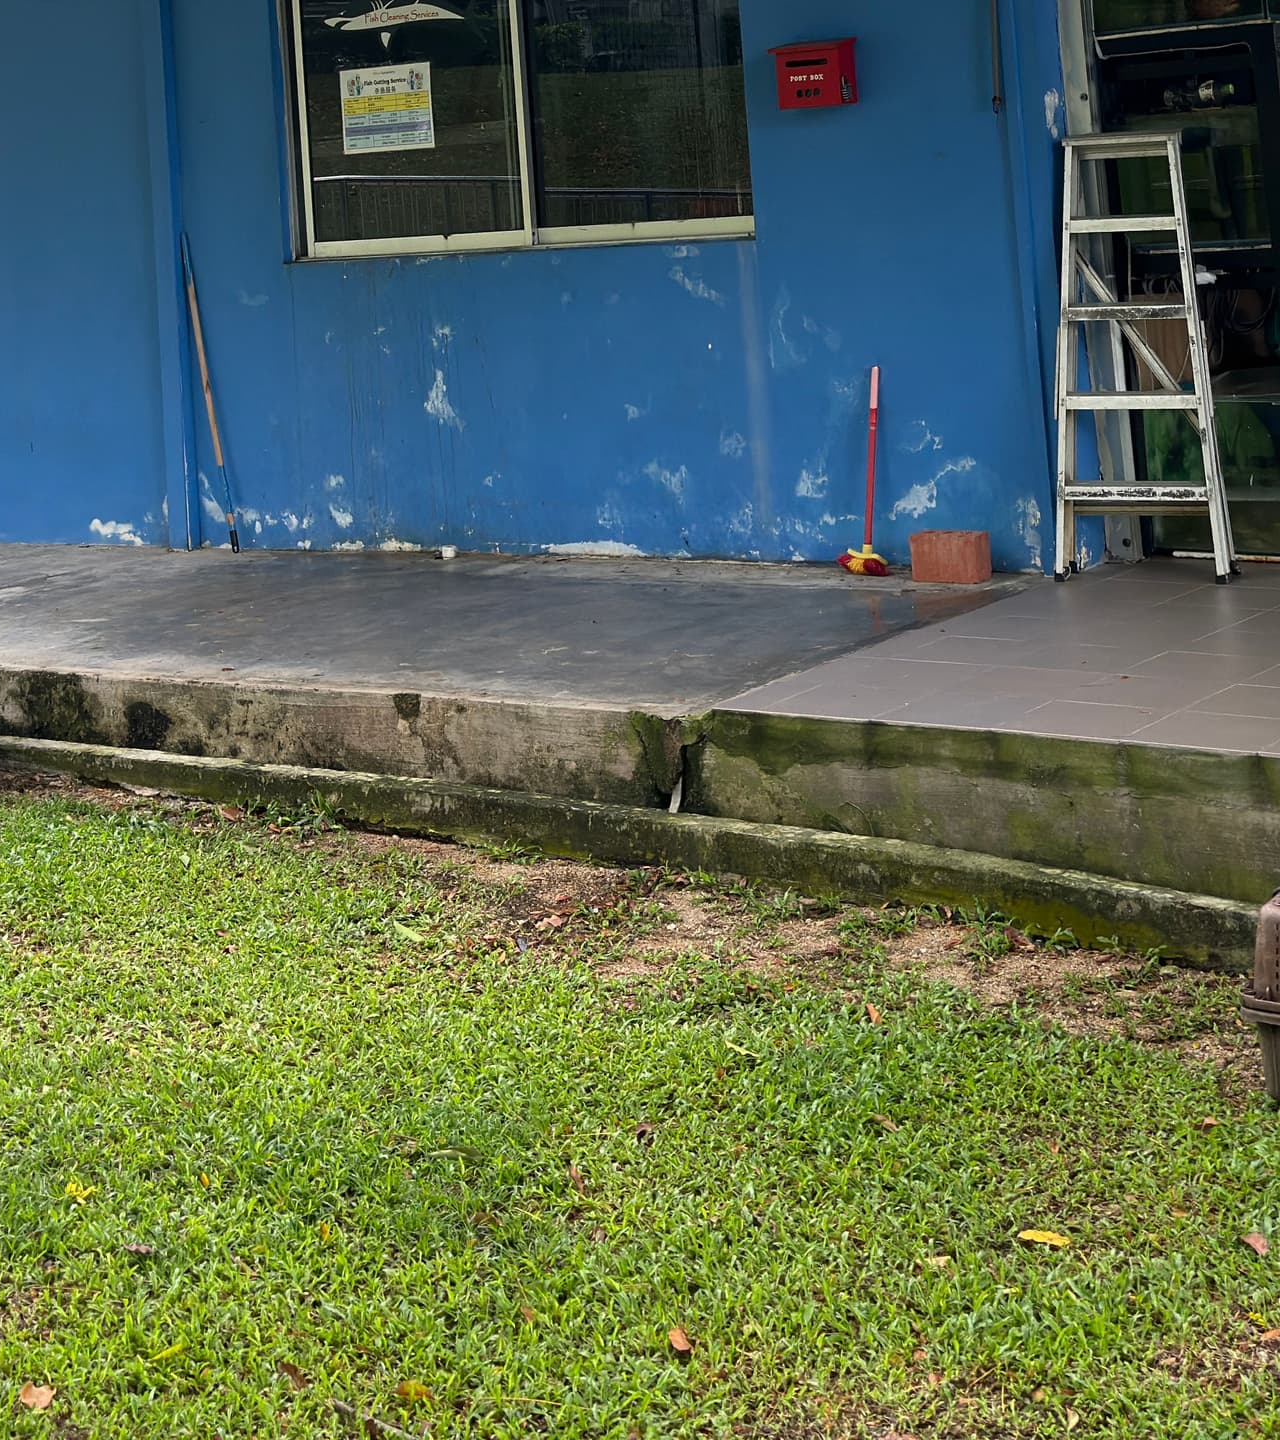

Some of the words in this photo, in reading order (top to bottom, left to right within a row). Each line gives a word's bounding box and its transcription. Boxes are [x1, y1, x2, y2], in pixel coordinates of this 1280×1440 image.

[364, 13, 379, 25] Fish
[379, 11, 410, 24] Cleaning
[410, 9, 440, 21] Services
